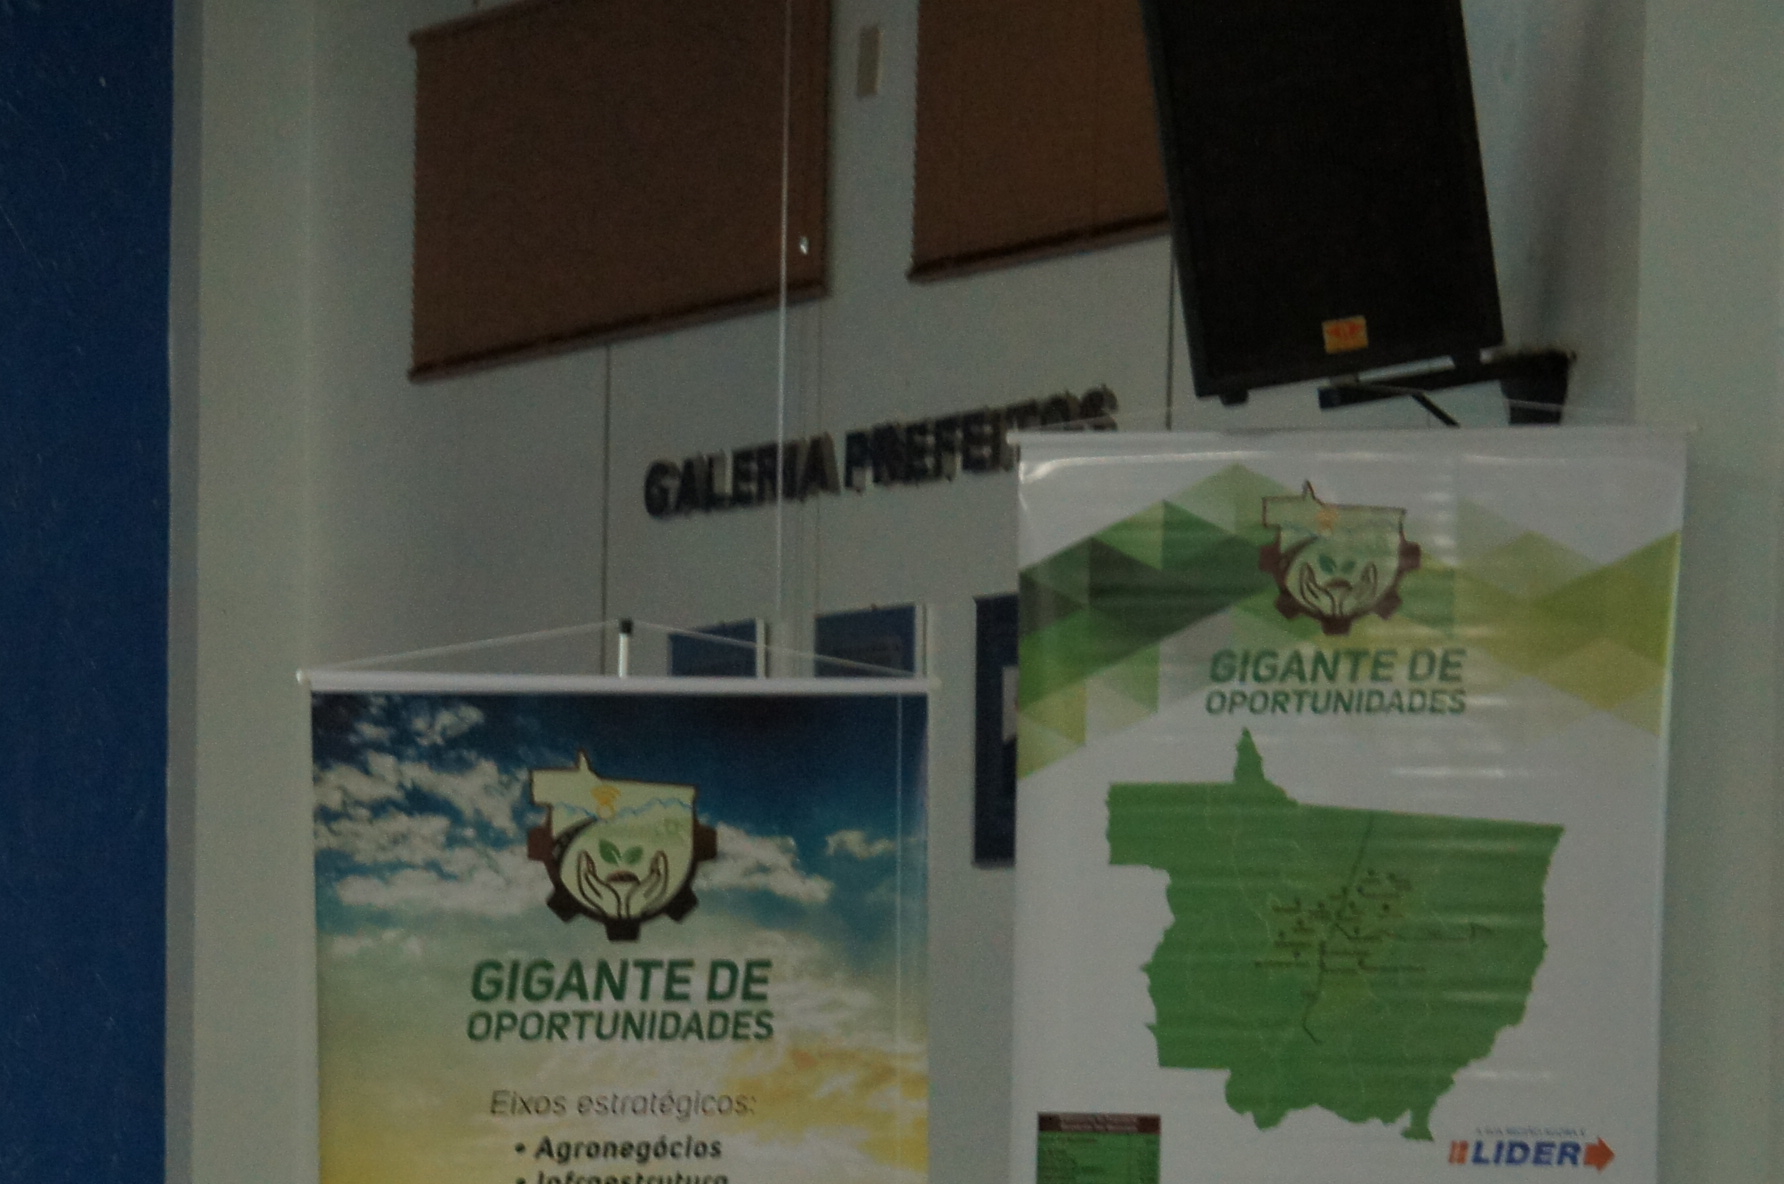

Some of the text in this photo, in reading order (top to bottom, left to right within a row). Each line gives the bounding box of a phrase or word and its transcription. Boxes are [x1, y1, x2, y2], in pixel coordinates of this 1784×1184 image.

[643, 432, 840, 518] GALERIA
[1209, 648, 1466, 684] GIGANTE DE
[1205, 689, 1467, 715] OPORTUNIDADES
[470, 958, 772, 1003] GIGANTE DE
[466, 1008, 775, 1044] OPORTUNIDADES
[489, 1089, 756, 1122] Eixos estratégicos:
[534, 1135, 722, 1166] Agronegócios
[1472, 1141, 1582, 1166] LIDER
